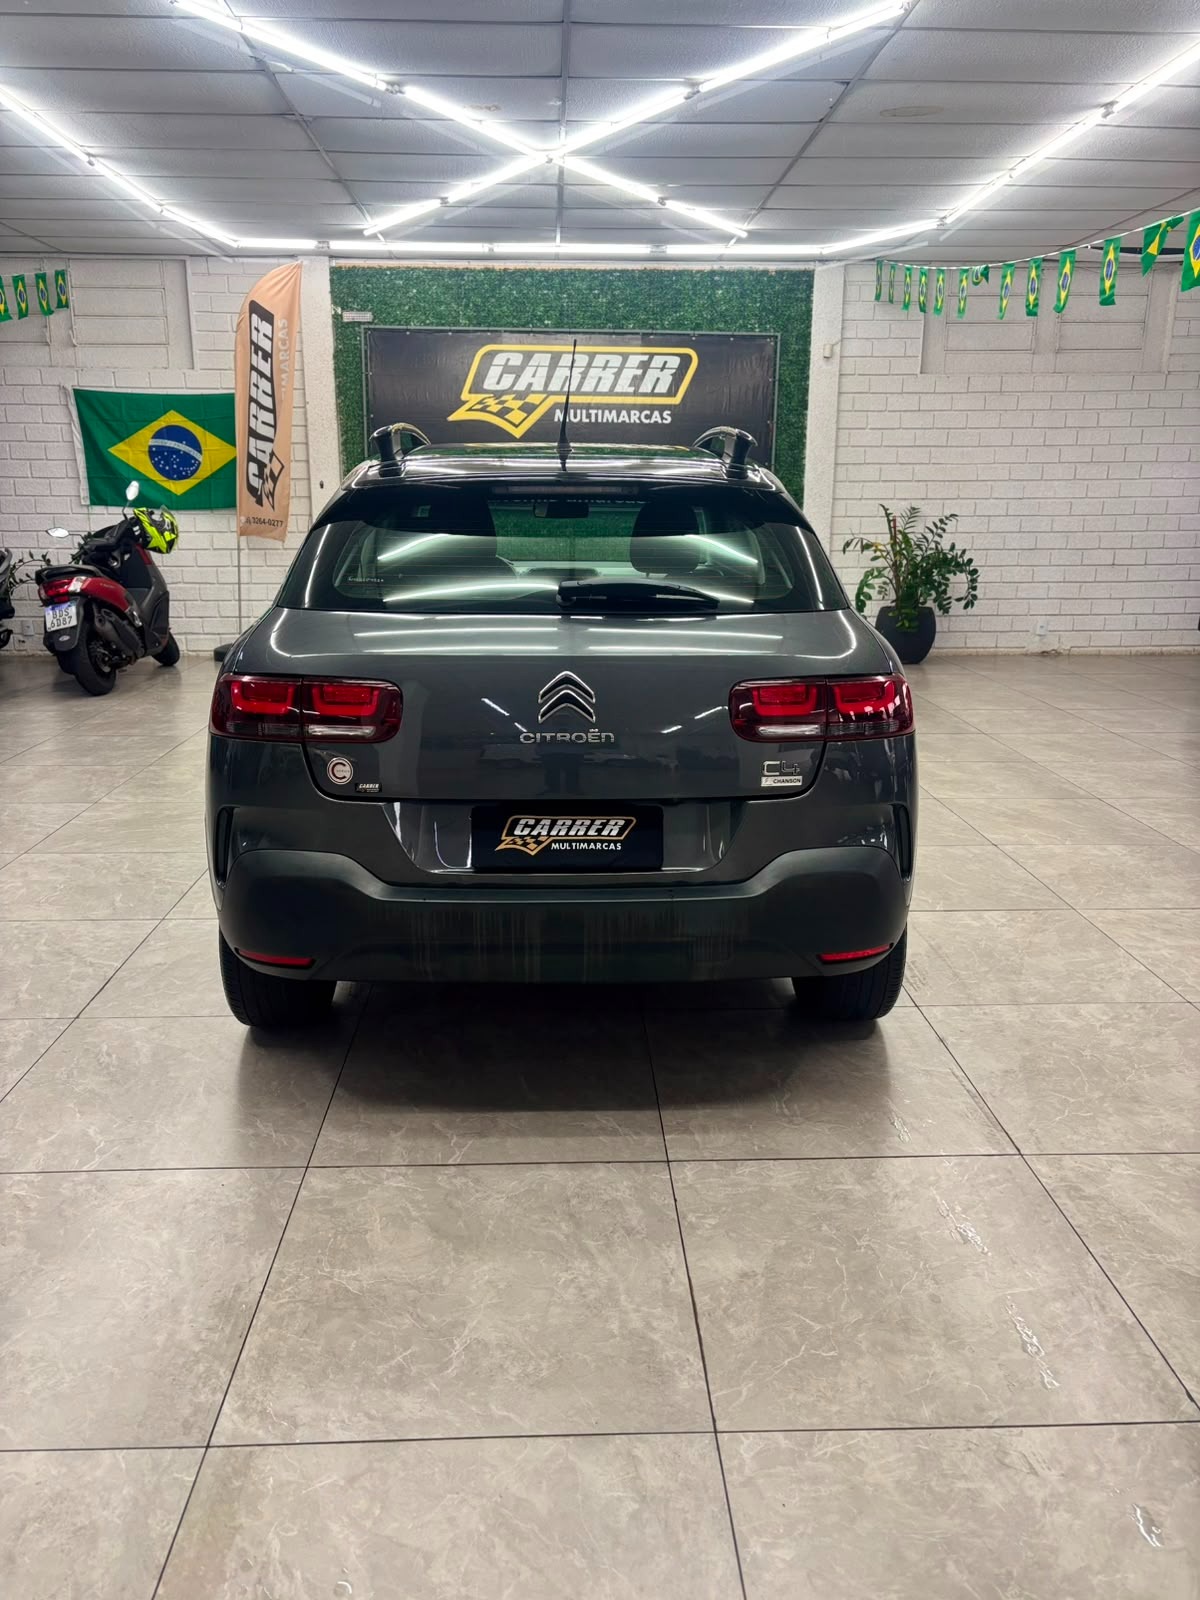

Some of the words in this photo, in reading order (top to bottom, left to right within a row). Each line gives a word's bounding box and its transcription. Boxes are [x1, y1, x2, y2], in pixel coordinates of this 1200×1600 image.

[483, 352, 681, 394] CARRER
[248, 312, 275, 490] CARRER
[554, 408, 672, 424] MULTIMARCAS
[762, 760, 800, 776] C4
[513, 818, 626, 836] CARRER
[550, 842, 622, 850] MULTIMARCAS
